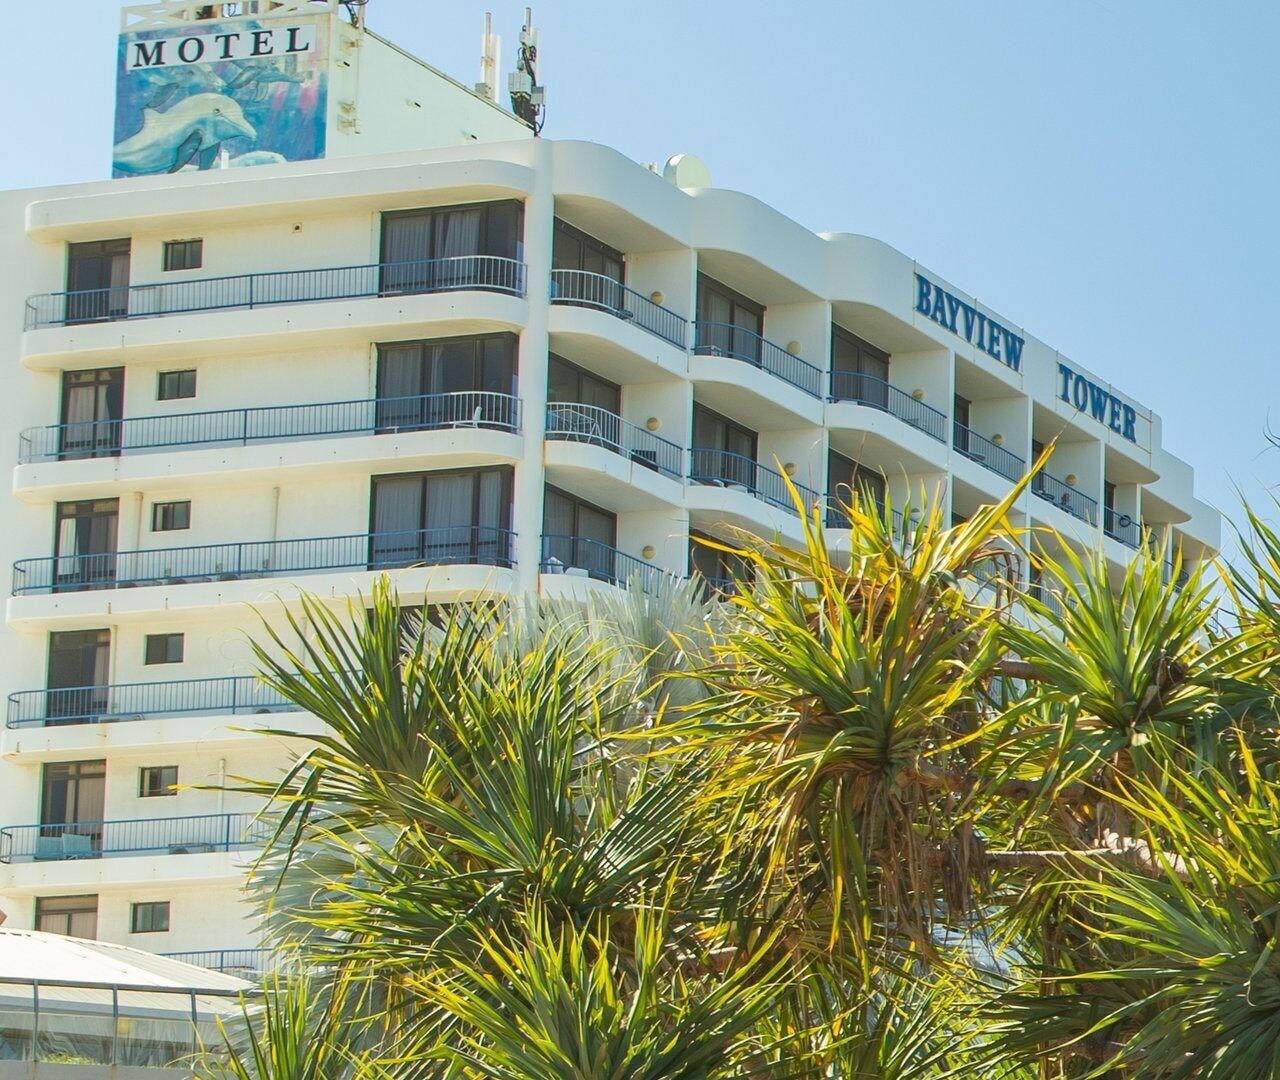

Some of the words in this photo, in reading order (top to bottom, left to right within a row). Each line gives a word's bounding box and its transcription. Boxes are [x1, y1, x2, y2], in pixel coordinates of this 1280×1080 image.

[133, 27, 310, 67] MOTEL
[914, 273, 1025, 372] BAYVIEW
[1058, 363, 1137, 443] TOWER
